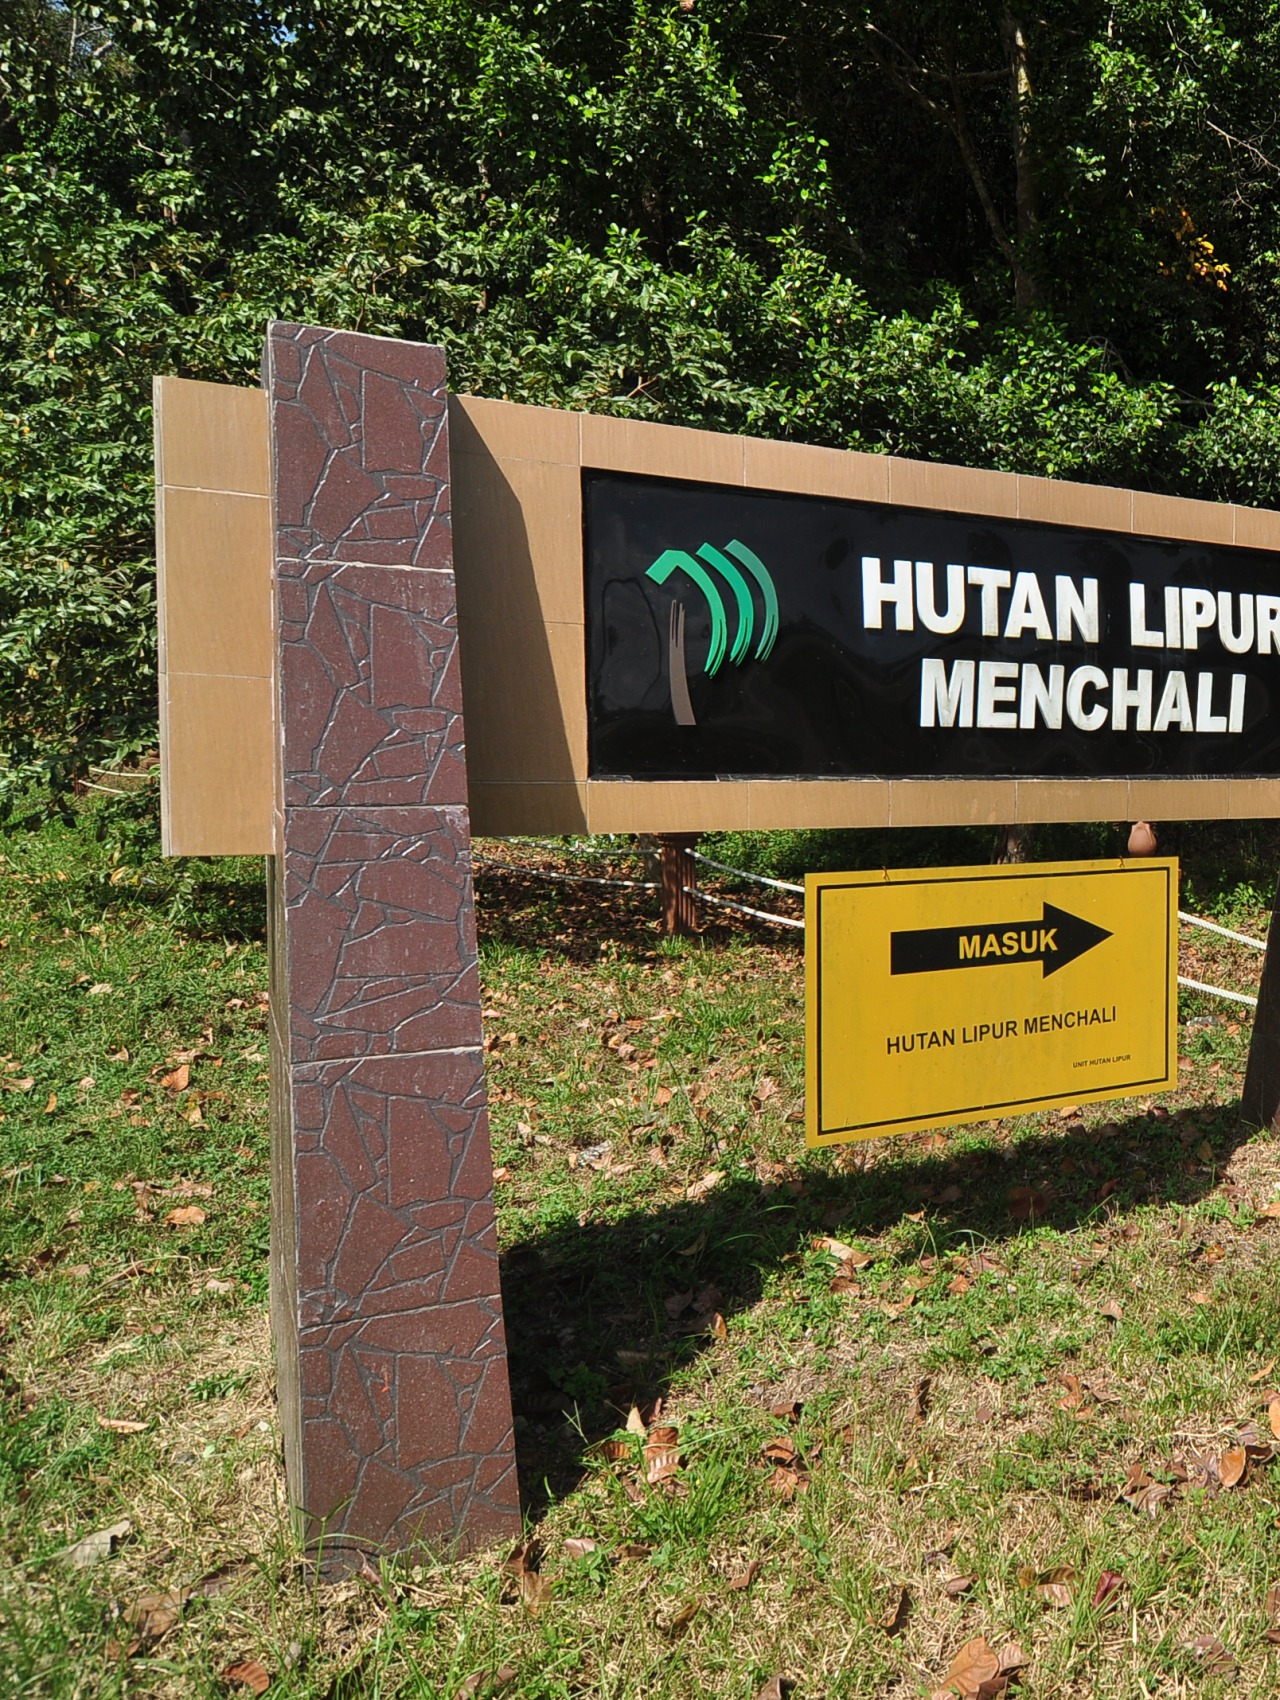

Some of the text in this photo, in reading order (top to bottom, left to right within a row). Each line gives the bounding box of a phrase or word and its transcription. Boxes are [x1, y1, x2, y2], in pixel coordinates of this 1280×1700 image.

[861, 557, 1099, 643] HUTAN
[919, 659, 1246, 734] MENCHALI
[958, 928, 1058, 959] MASUK
[886, 1006, 1117, 1055] HUTAN LIPUR MENCHALI
[1072, 1054, 1131, 1068] UNIT HUTAN LIPUR
